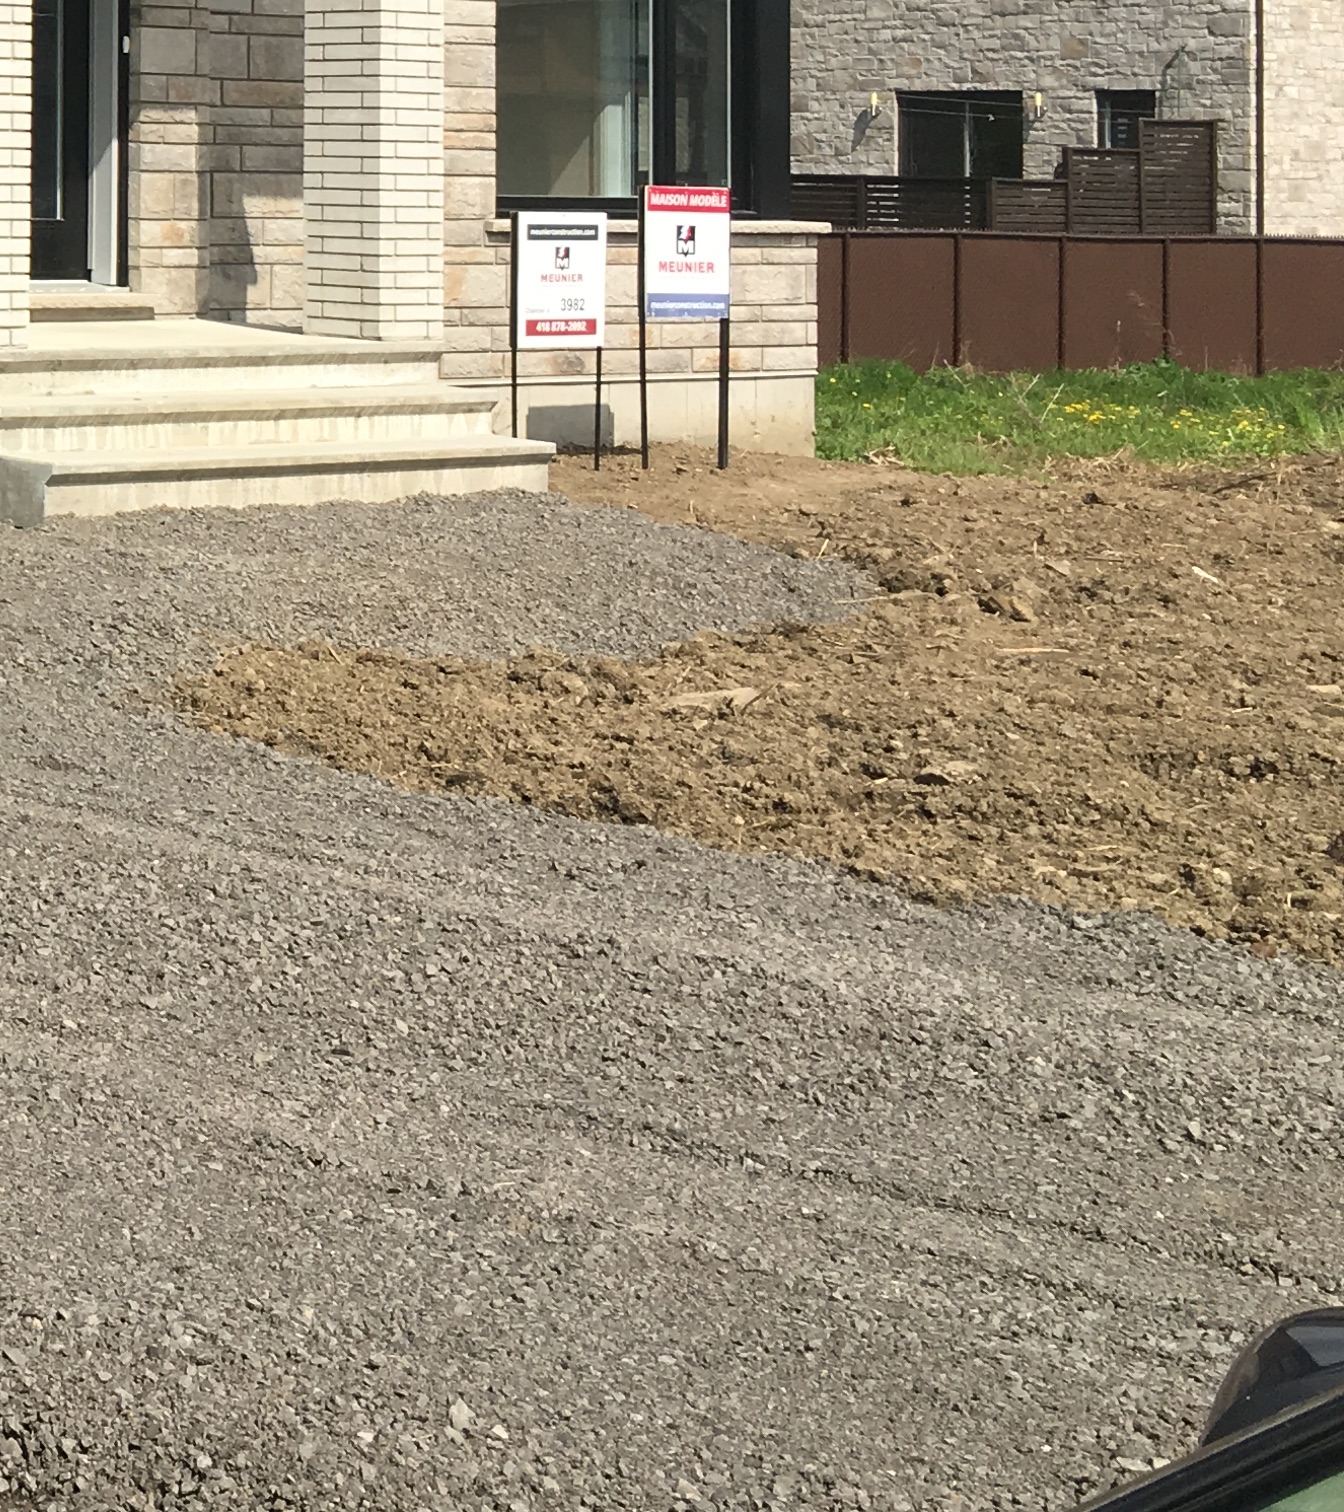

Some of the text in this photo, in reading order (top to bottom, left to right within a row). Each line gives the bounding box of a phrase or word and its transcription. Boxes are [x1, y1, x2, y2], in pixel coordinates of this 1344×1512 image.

[650, 192, 727, 207] MAISON MODÈLE
[658, 261, 715, 273] MEUNIER
[540, 273, 584, 283] MEUNIER
[560, 298, 585, 311] 3982
